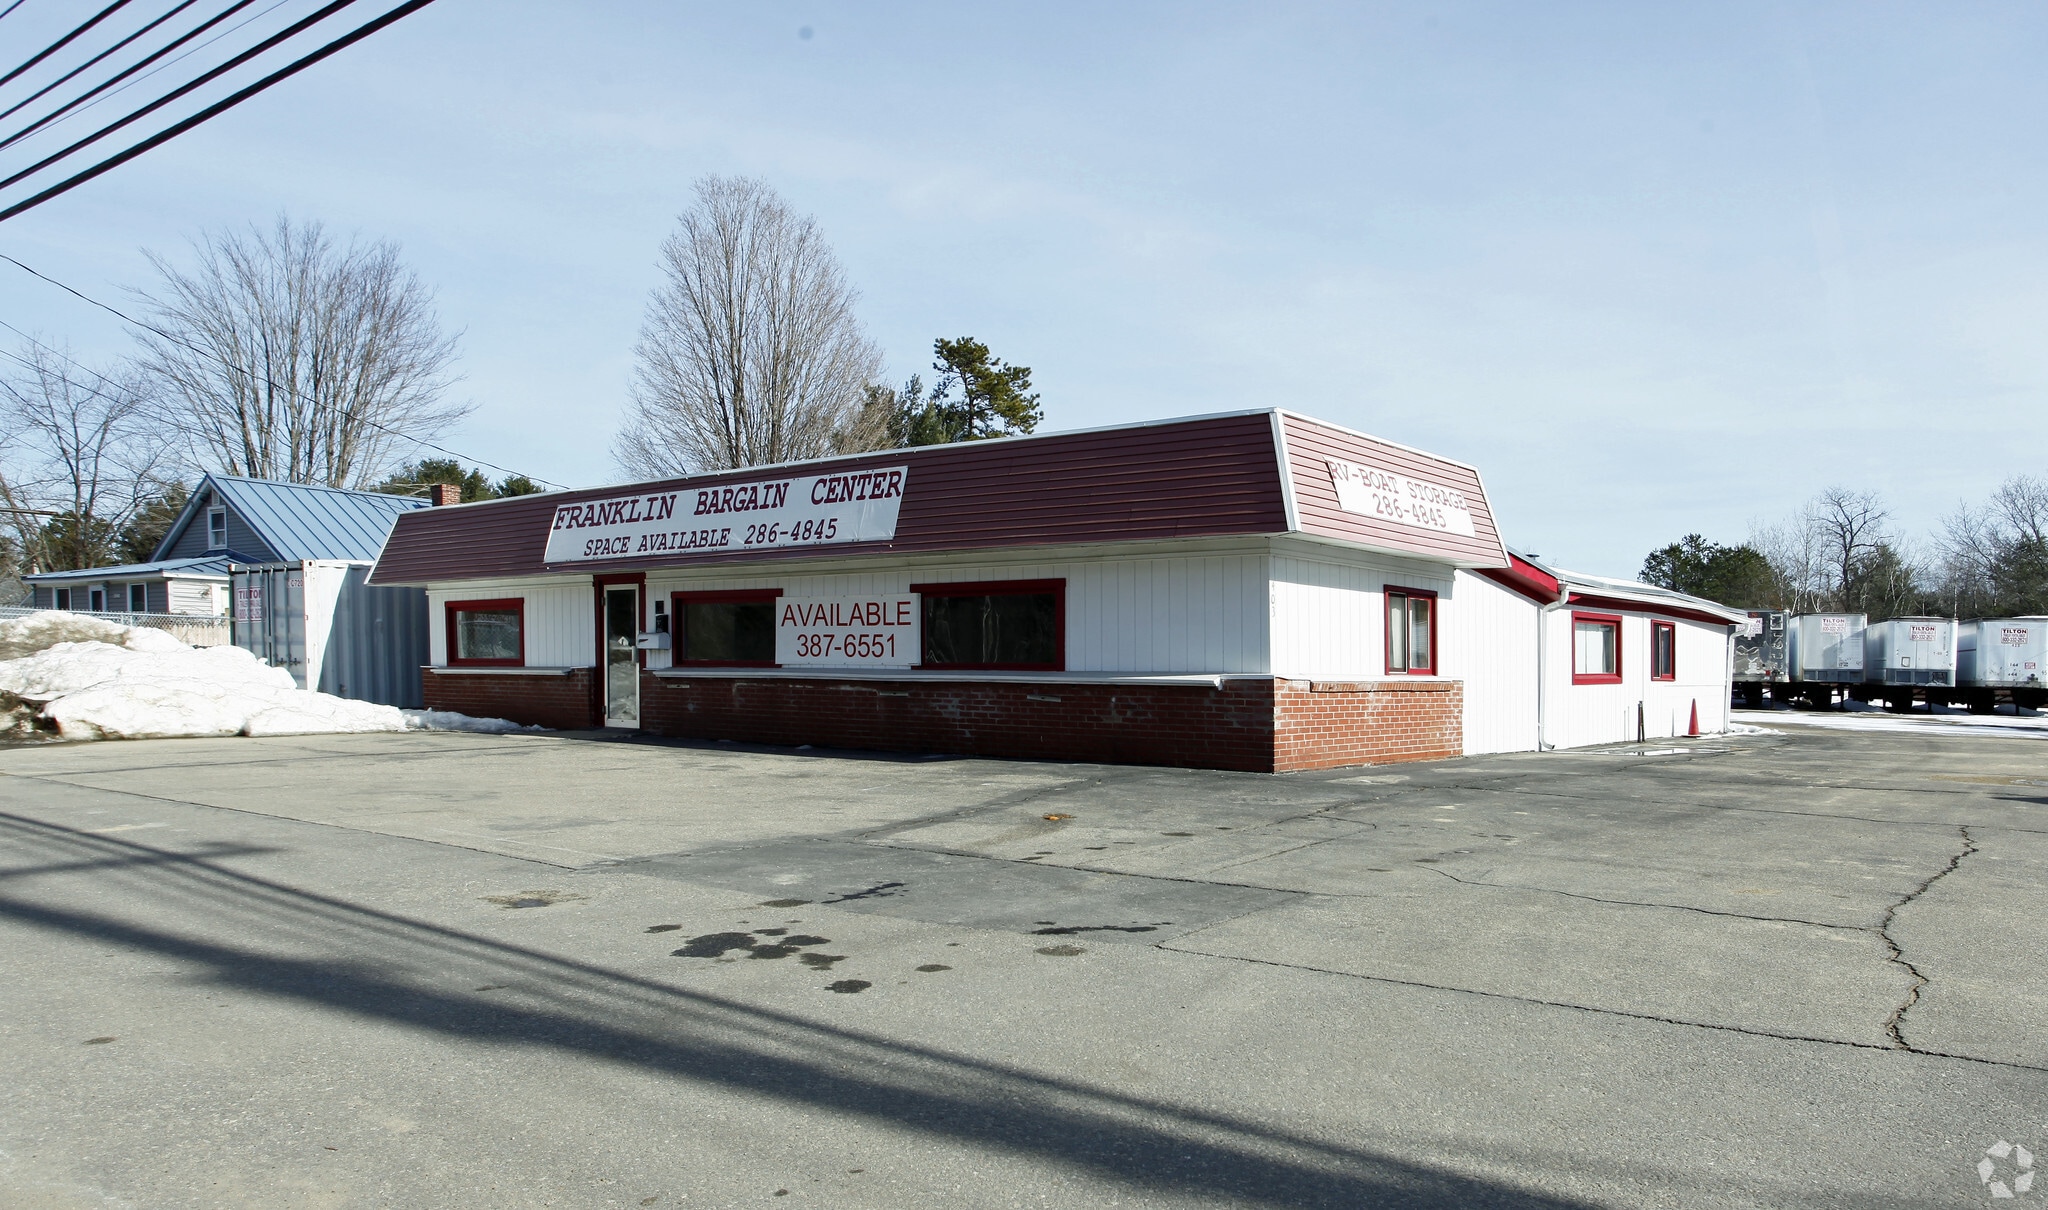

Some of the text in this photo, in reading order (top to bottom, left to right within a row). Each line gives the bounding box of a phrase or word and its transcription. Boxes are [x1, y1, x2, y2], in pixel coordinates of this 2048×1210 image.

[553, 470, 903, 530] FRANKLIN BARGAIN CENTER
[1329, 460, 1468, 511] RV-BOAT STORAGE
[1372, 493, 1447, 529] 286-4845
[584, 518, 838, 557] SPACE AVAILABLE 286-4845
[781, 601, 912, 627] AVAILABLE
[796, 633, 895, 658] 387-6551
